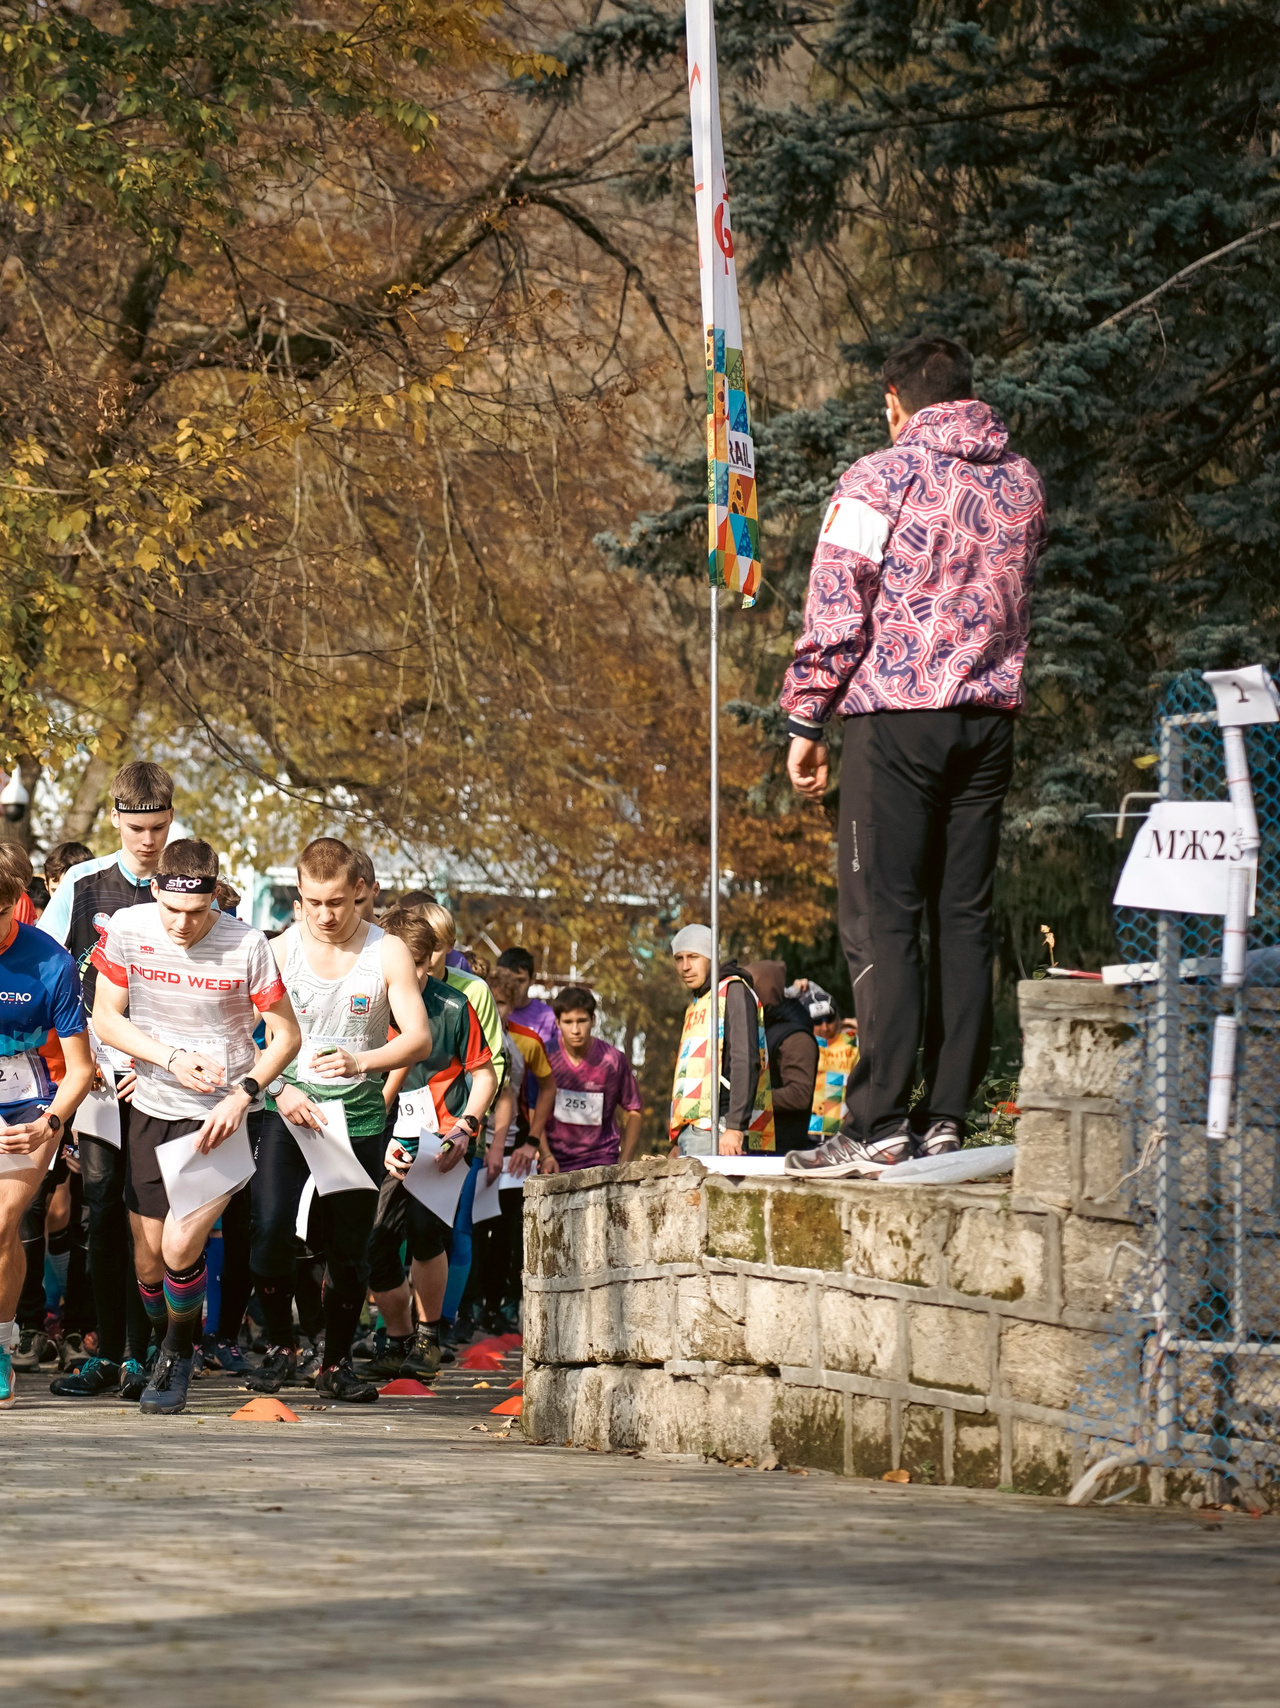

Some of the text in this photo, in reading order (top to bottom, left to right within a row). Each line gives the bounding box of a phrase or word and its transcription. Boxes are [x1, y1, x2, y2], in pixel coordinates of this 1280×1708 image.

[130, 963, 181, 985] NORD
[187, 975, 246, 991] WEST
[398, 1103, 415, 1117] 19
[565, 1098, 587, 1110] 255
